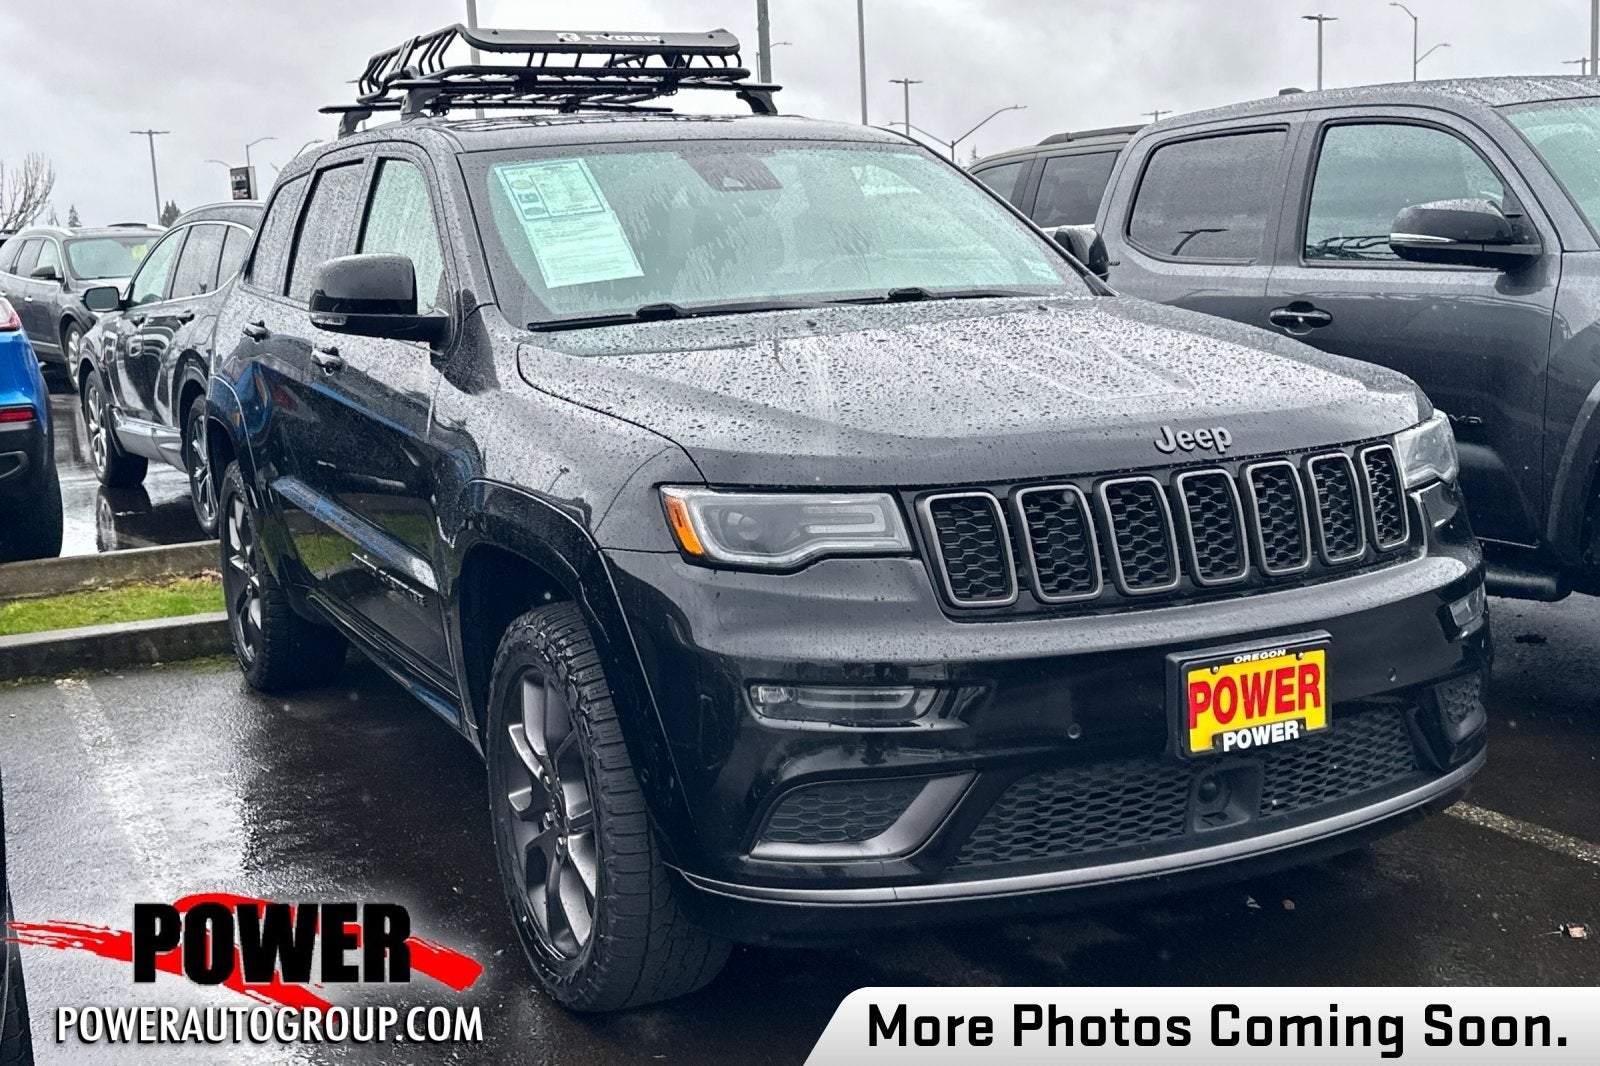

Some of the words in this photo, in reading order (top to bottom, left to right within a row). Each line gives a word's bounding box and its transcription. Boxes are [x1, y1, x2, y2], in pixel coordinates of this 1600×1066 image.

[585, 34, 662, 42] TYGER
[1154, 425, 1233, 454] Jeep
[1233, 649, 1287, 664] OREGON
[1188, 663, 1321, 729] POWER
[1223, 720, 1299, 752] POWER
